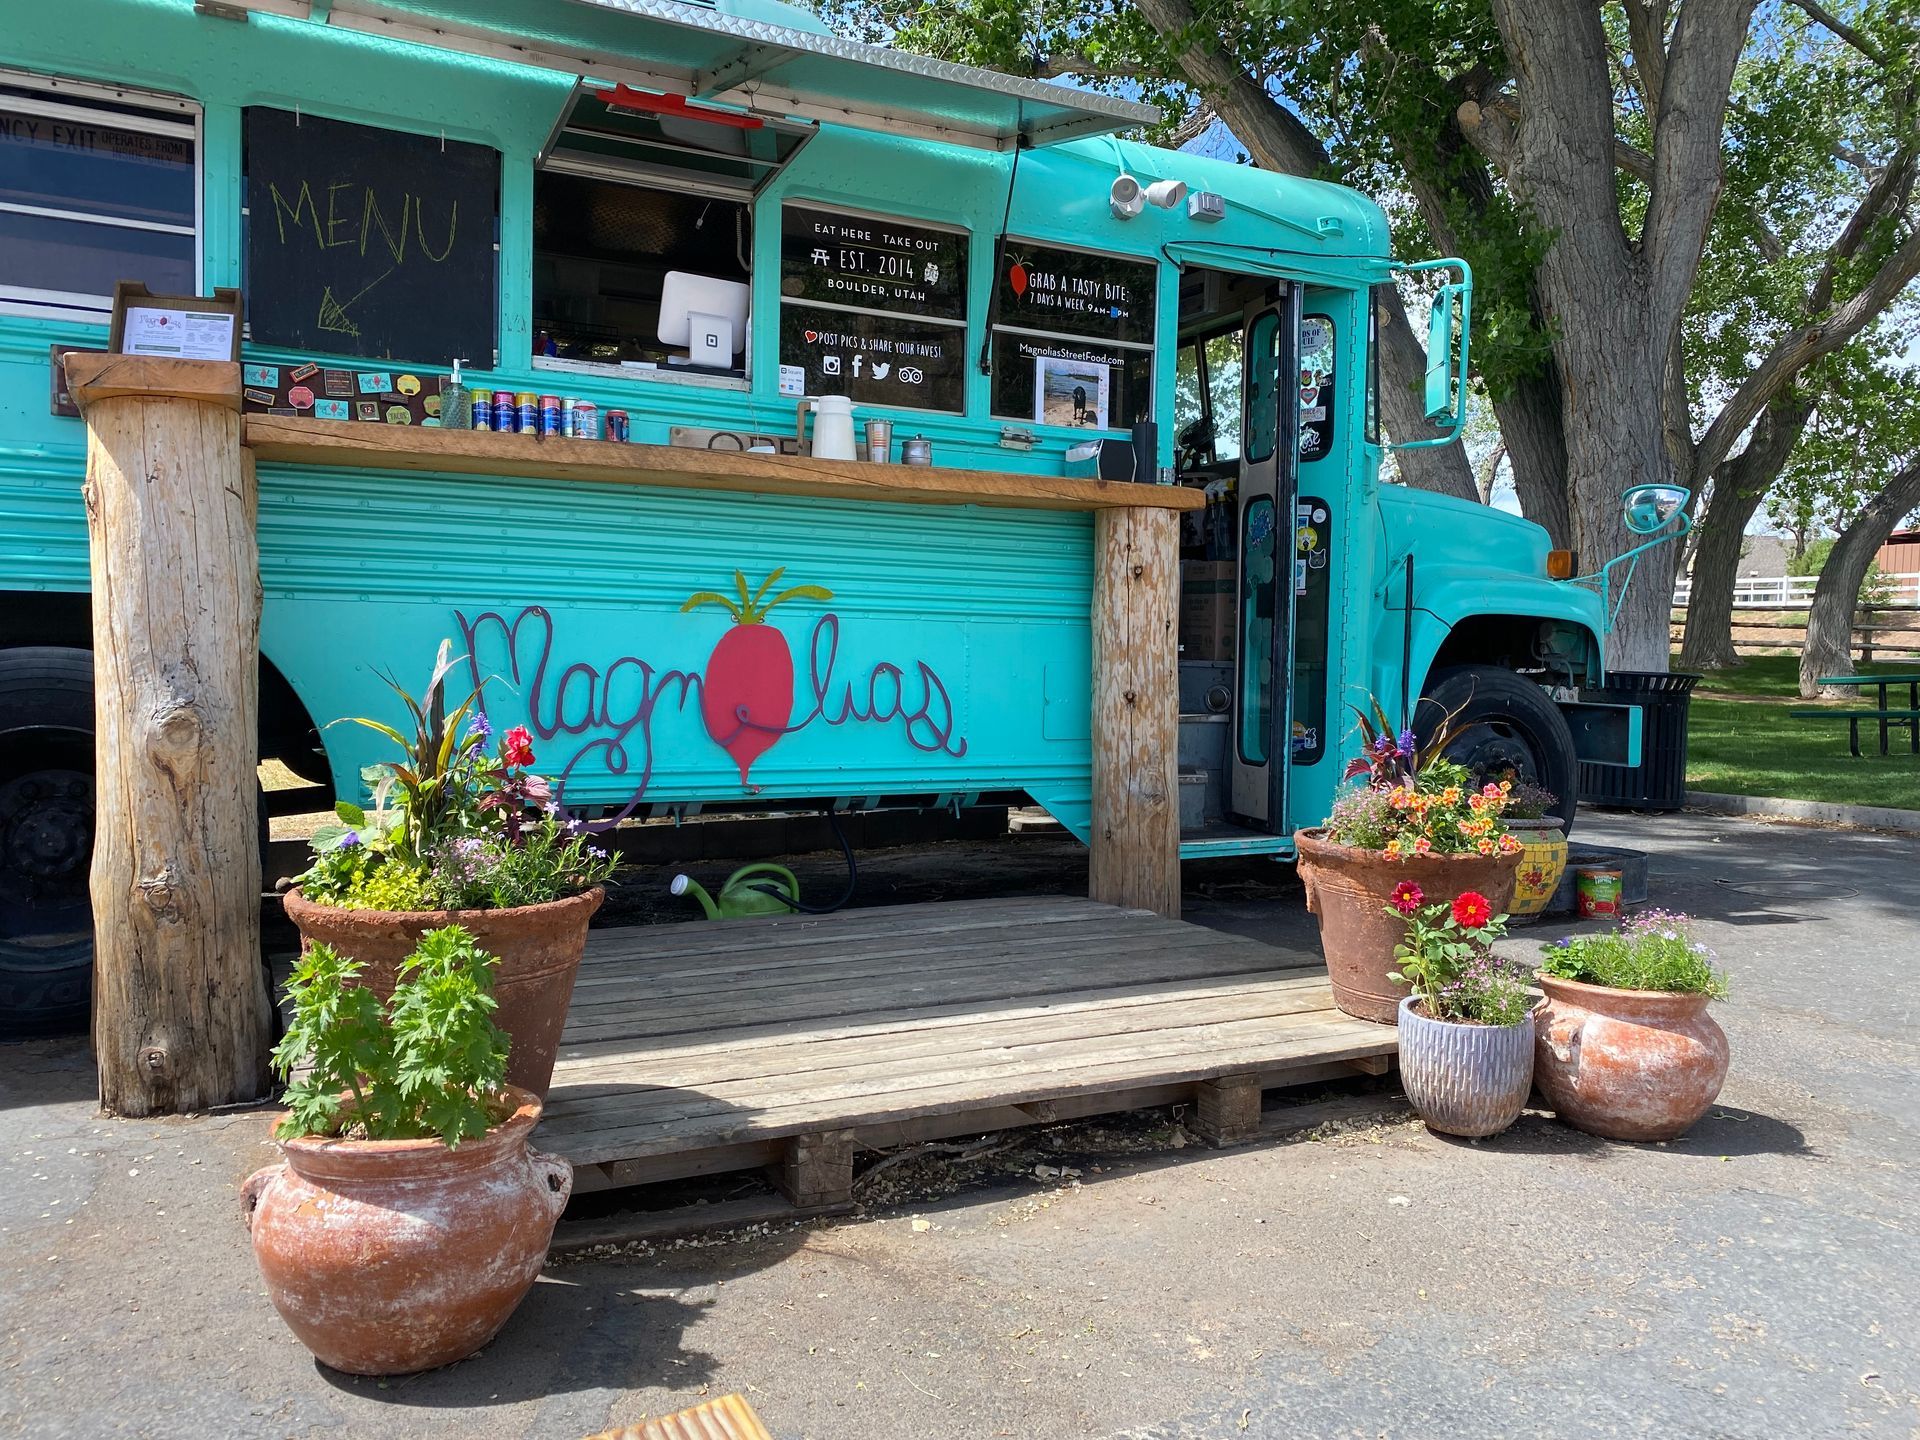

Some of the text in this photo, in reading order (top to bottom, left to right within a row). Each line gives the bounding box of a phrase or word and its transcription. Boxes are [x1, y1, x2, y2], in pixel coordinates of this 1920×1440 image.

[52, 125, 97, 153] EXIT
[101, 131, 183, 156] OPERATES FROM
[269, 179, 457, 265] MENU
[814, 223, 939, 252] EAT HERE TAKE OUT
[840, 249, 914, 279] EST. 2014
[827, 278, 926, 302] BOULDER, UTAH
[1029, 272, 1130, 303] GRAB A TASTY BITE:
[1030, 291, 1129, 318] 7 DAYS A WEEK 9AM-PM
[818, 331, 942, 359] POST PICS & SHARE YOUR FAVES!
[1019, 342, 1125, 366] MagnoliasStreetFood.com
